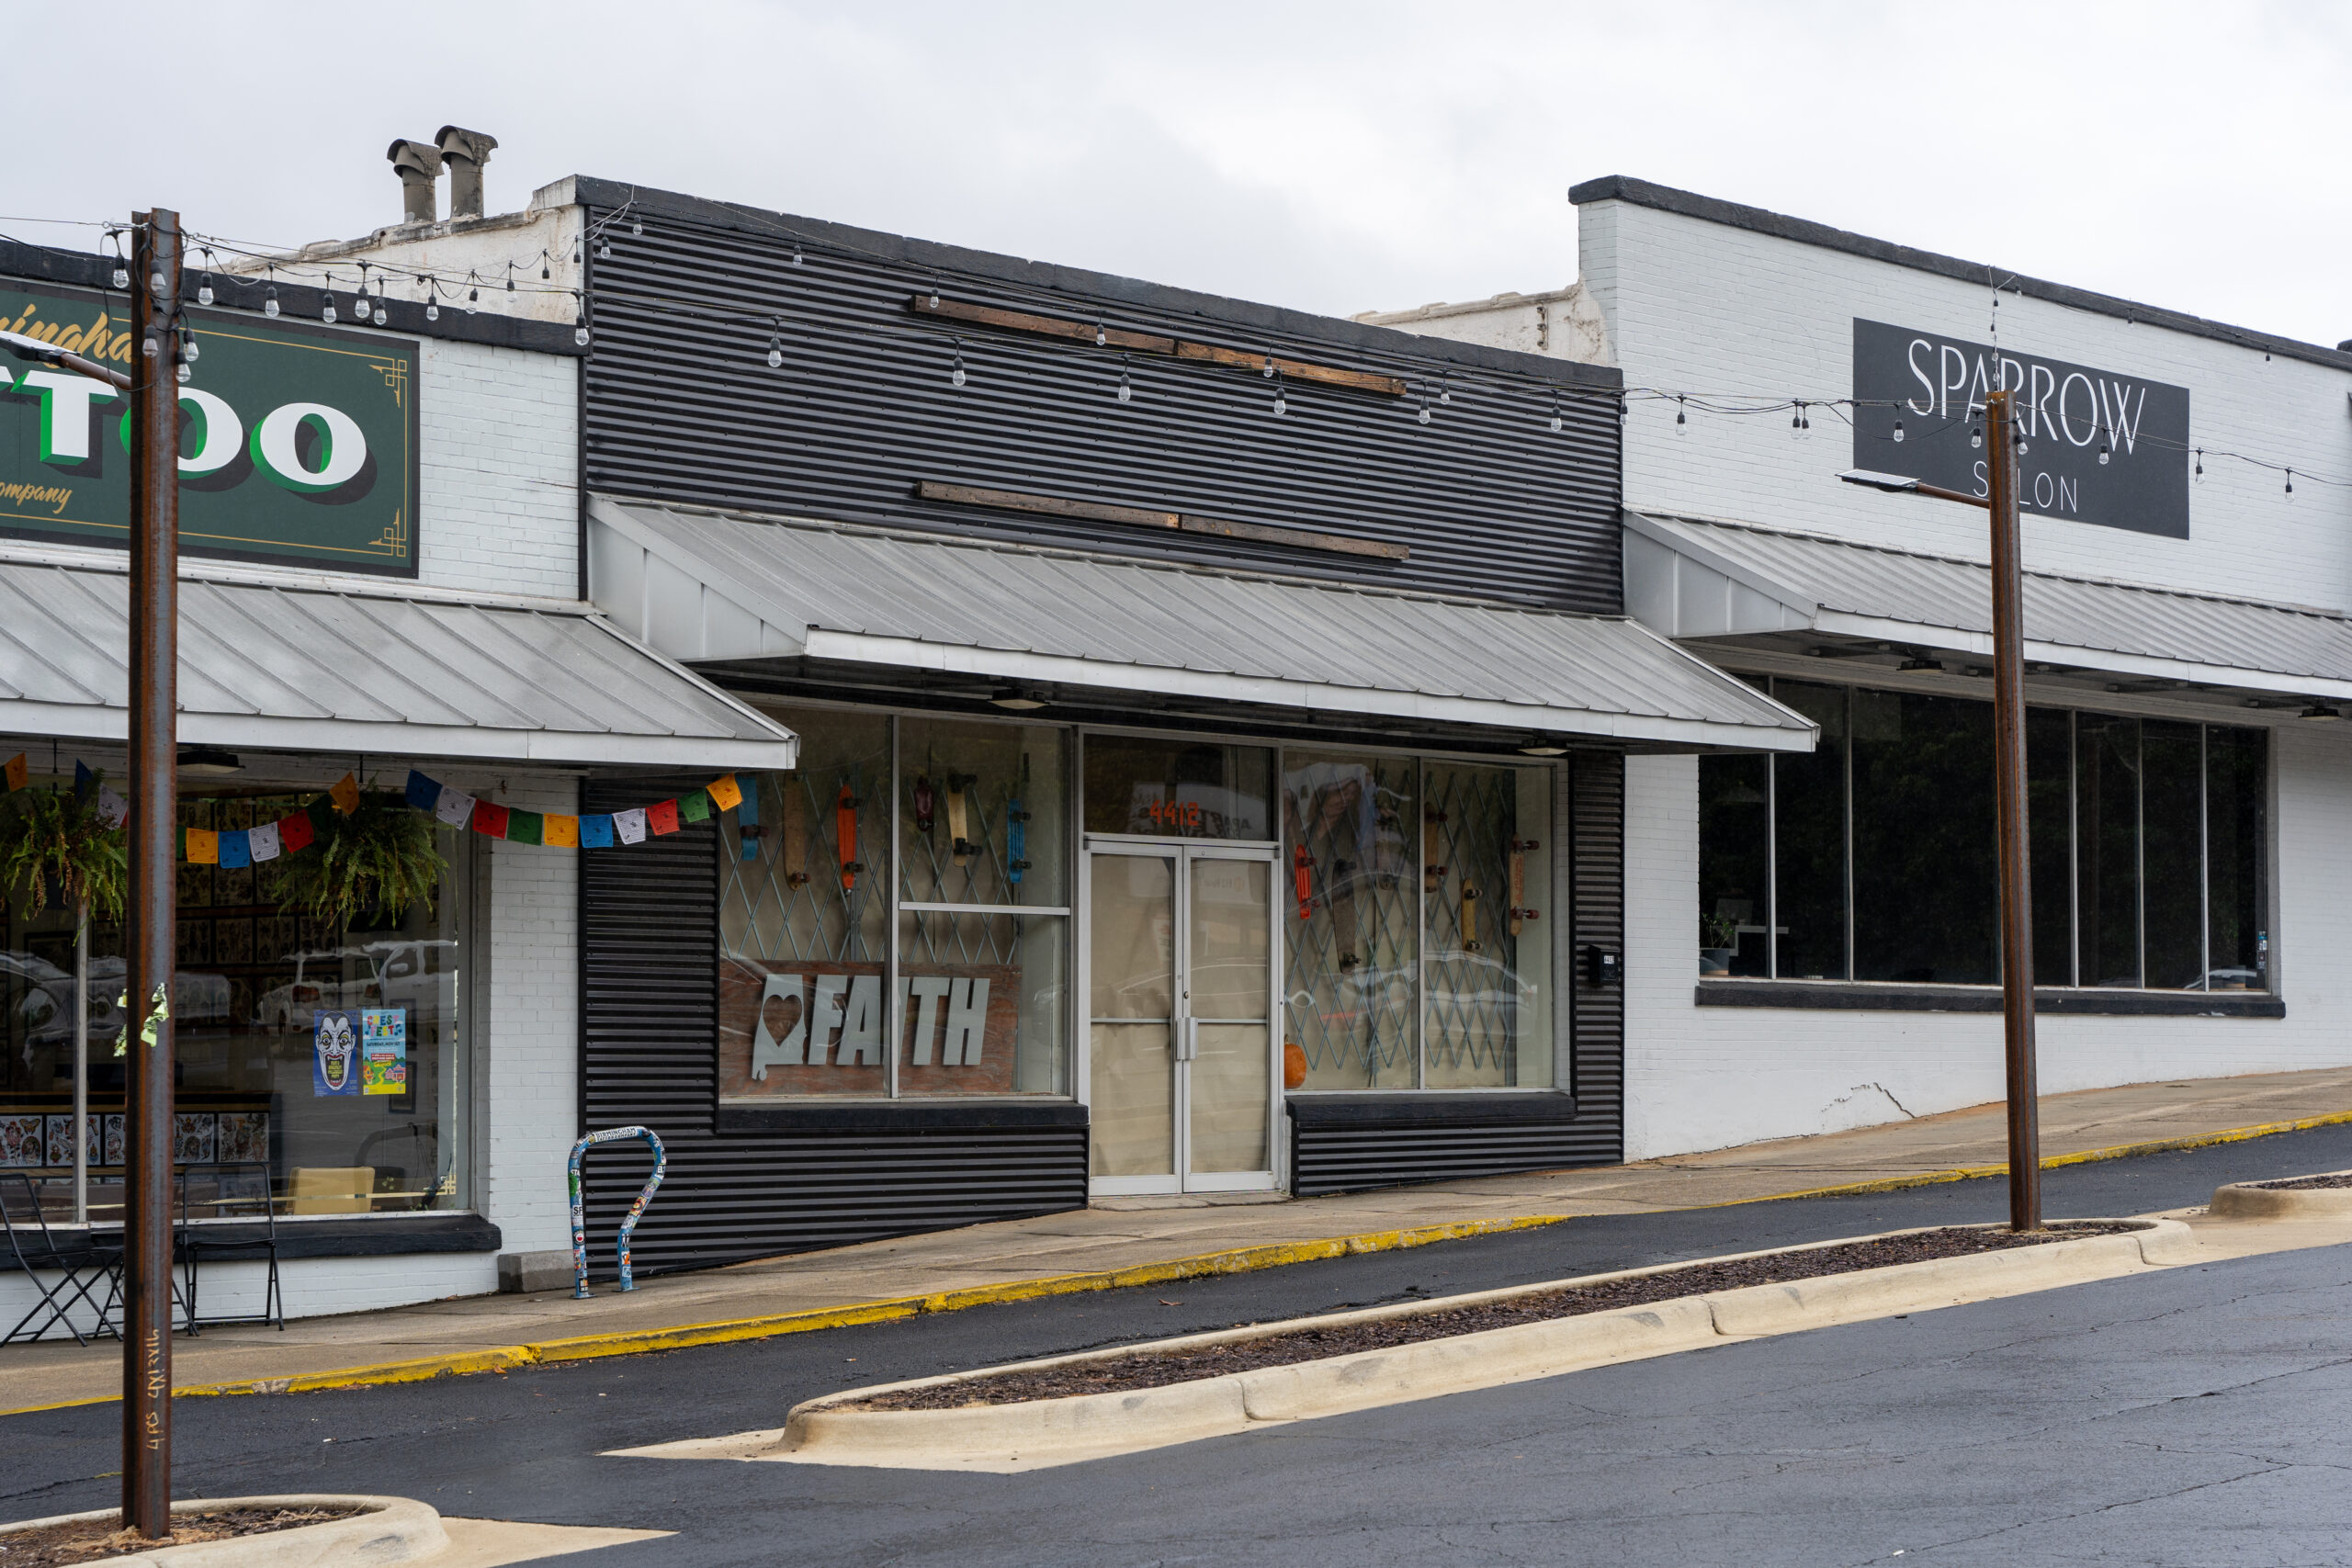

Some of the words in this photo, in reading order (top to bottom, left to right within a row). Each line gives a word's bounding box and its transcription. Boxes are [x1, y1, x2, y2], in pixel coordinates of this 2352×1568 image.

[0, 303, 131, 369] ingha
[1907, 338, 2145, 456] SPARROW
[0, 365, 368, 493] TOO
[1973, 461, 2077, 513] SLON
[1149, 799, 1199, 827] 4412
[367, 1014, 400, 1026] CREST
[370, 1024, 395, 1037] FEST
